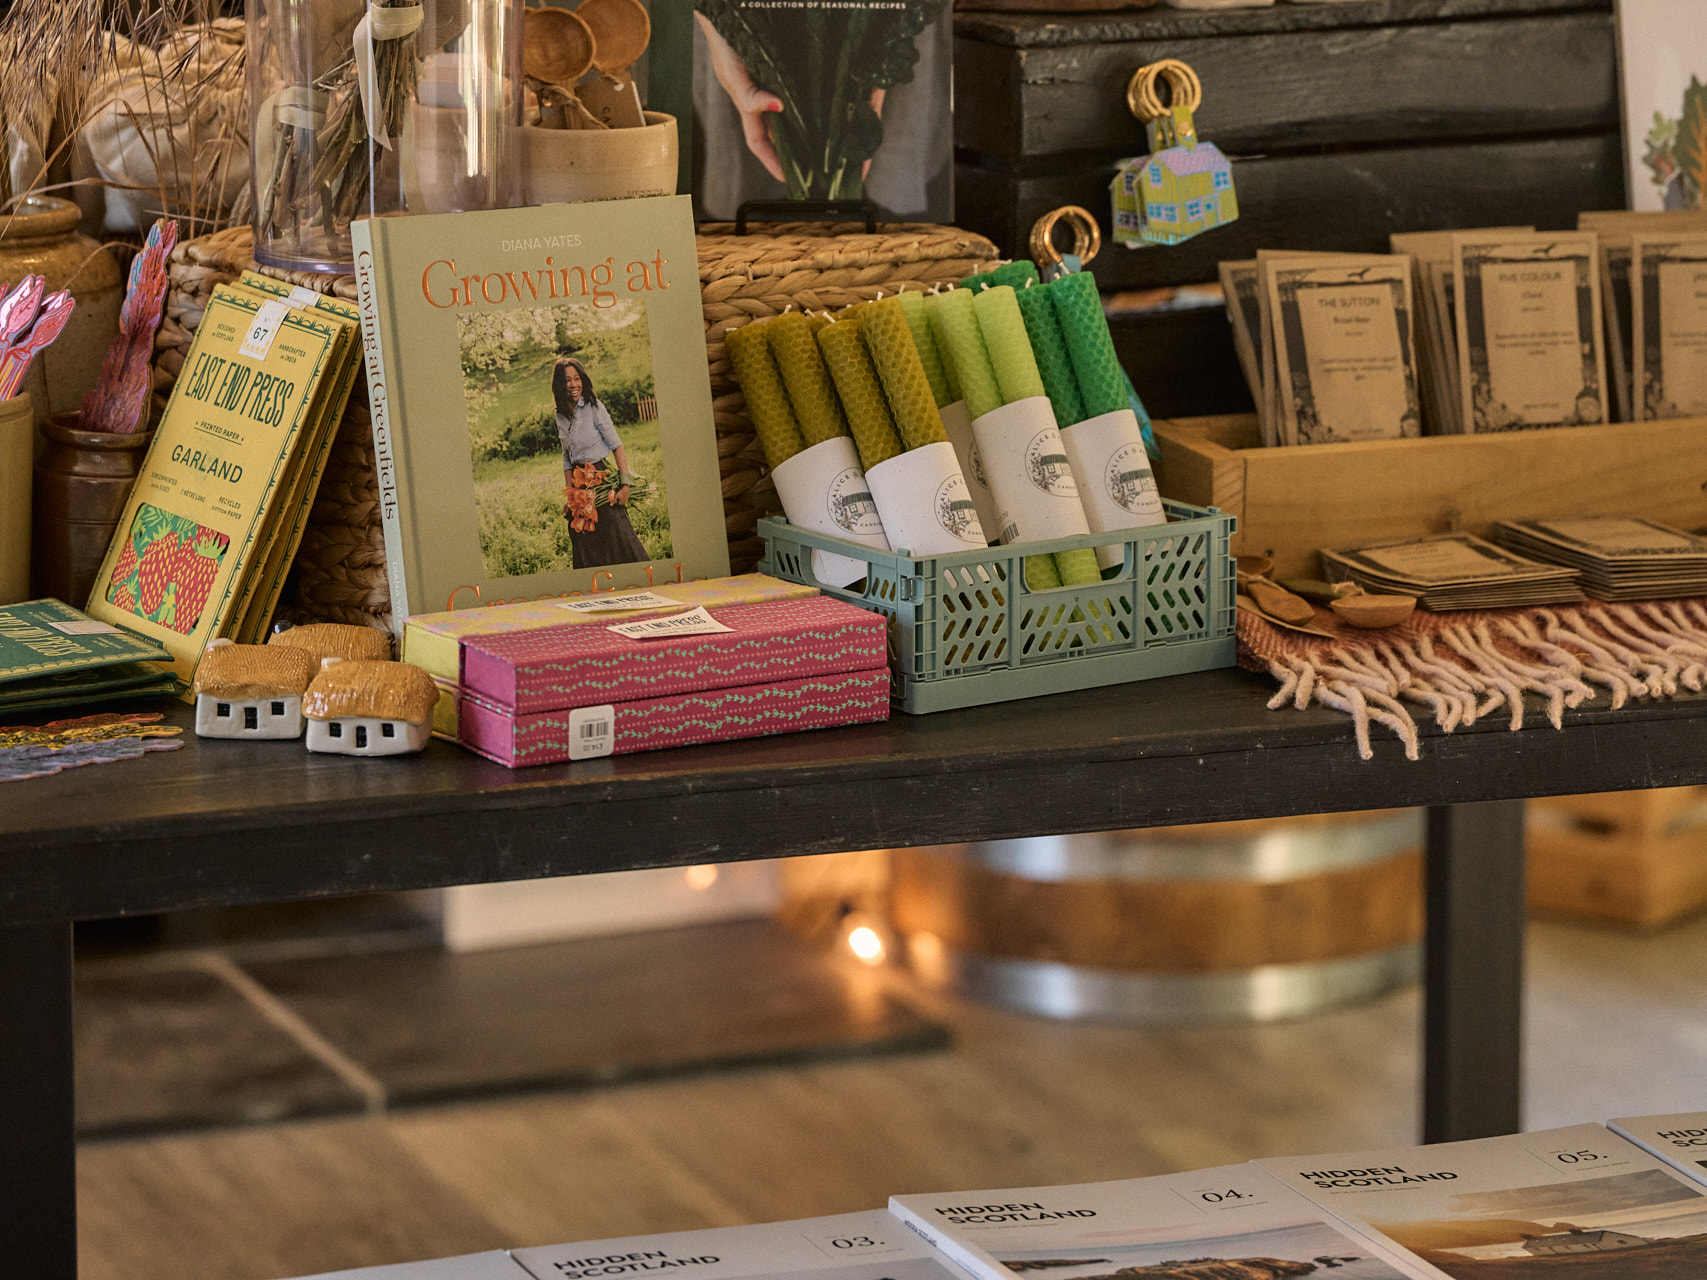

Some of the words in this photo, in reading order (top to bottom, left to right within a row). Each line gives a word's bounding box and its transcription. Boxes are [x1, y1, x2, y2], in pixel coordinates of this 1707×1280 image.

[821, 1, 867, 9] SEASONAL
[502, 237, 542, 252] DIANA
[543, 234, 581, 249] YATES
[421, 256, 617, 308] Growing
[626, 249, 670, 292] at
[358, 250, 379, 350] Growing
[253, 327, 269, 341] 67
[369, 356, 381, 379] at
[184, 352, 227, 402] EAST
[213, 361, 252, 412] END
[239, 370, 295, 428] PRESS
[200, 421, 222, 434] PRINTED
[222, 429, 240, 440] PAPER
[372, 382, 397, 521] Greenfields
[171, 444, 243, 483] GARLAND
[832, 474, 850, 497] ALICE
[218, 496, 241, 510] RECYCLED
[227, 509, 242, 520] PAPER
[392, 561, 400, 597] DIANA
[1656, 1128, 1707, 1139] HID
[1557, 1149, 1608, 1164] 05.
[1300, 1166, 1406, 1180] HIDDEN
[1314, 1171, 1458, 1189] SCOTLAND
[1201, 1189, 1254, 1202] 04.
[934, 1202, 1044, 1216] HIDDEN
[947, 1209, 1097, 1225] SCOTLAND
[831, 1235, 885, 1250] 03.
[553, 1250, 667, 1270] HIDDEN
[565, 1255, 720, 1279] SCOTLAND
